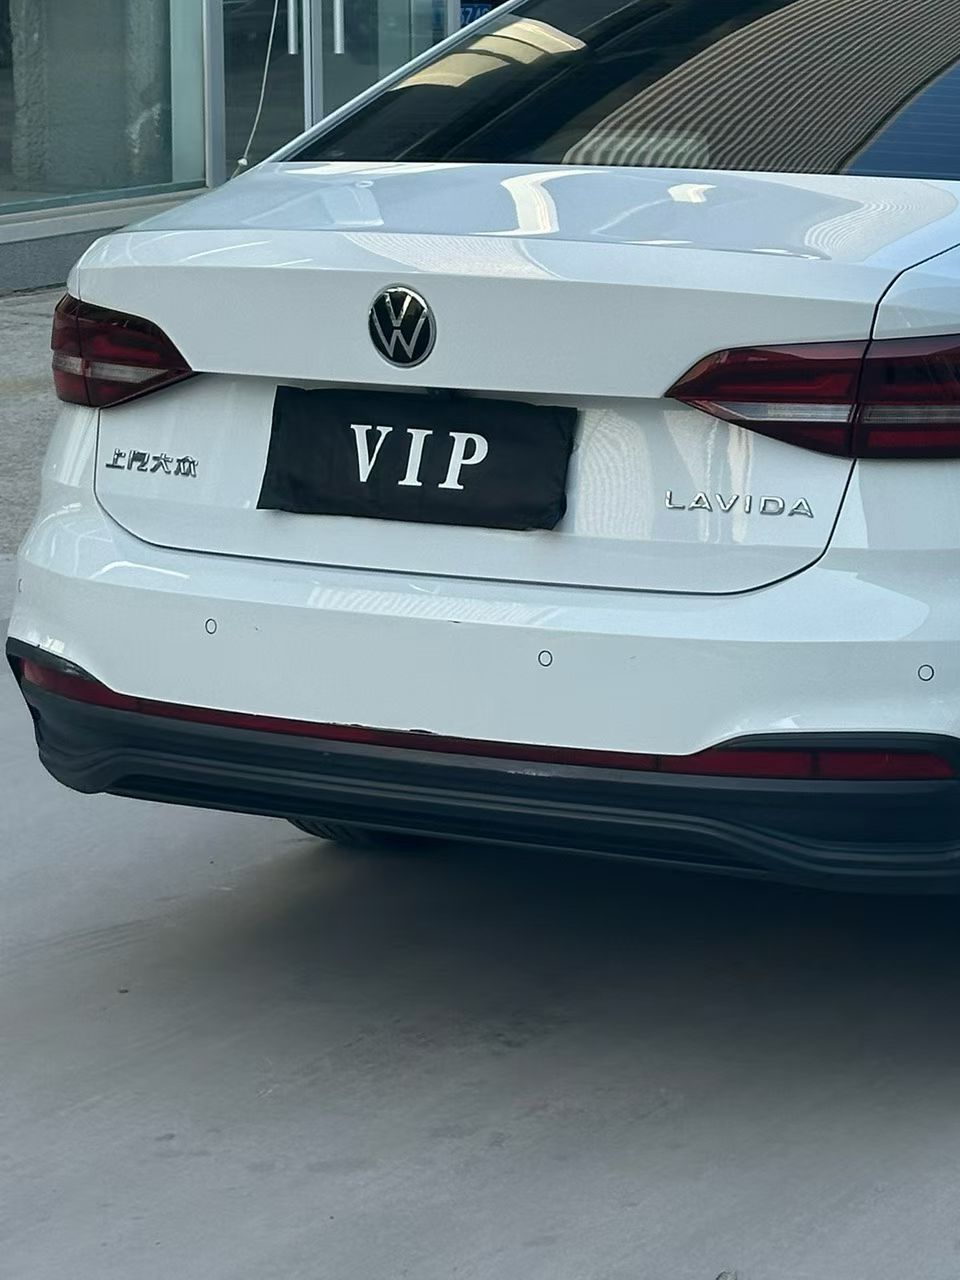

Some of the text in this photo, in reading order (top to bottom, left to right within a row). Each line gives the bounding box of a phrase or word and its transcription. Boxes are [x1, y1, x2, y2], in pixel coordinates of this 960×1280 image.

[105, 448, 199, 478] 上汽大众
[350, 423, 489, 490] VIP
[665, 490, 815, 519] LAVIDA
